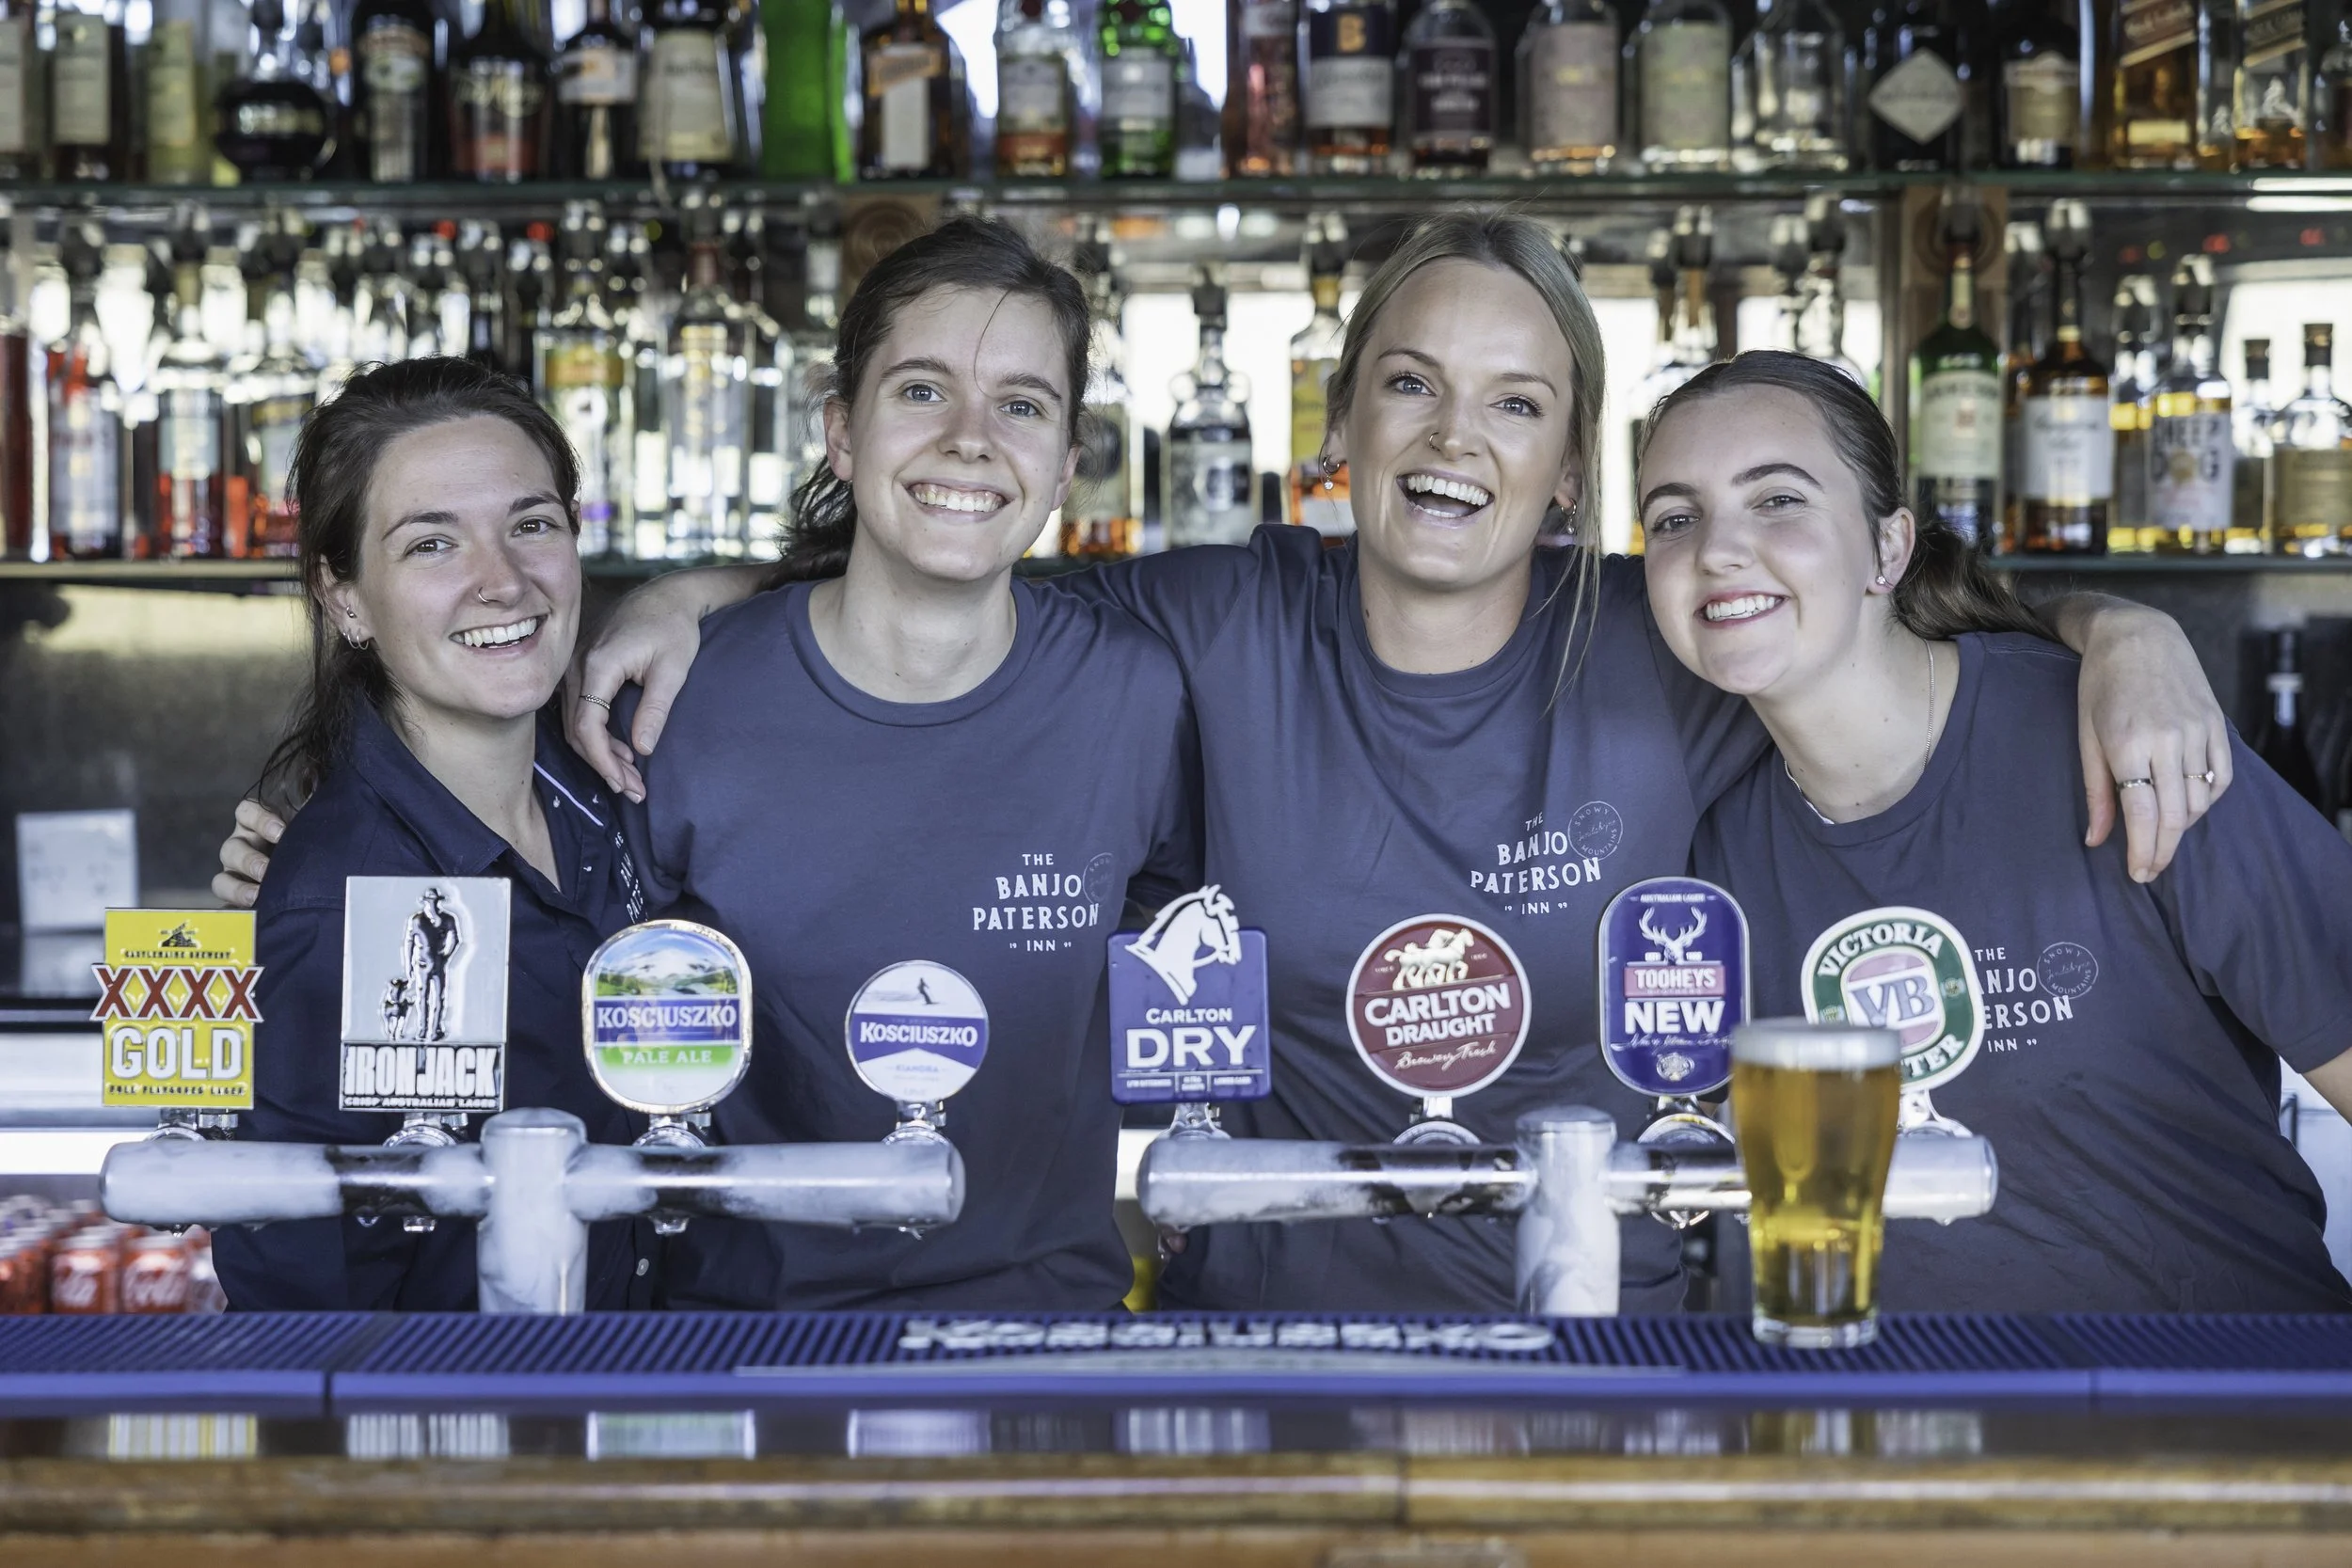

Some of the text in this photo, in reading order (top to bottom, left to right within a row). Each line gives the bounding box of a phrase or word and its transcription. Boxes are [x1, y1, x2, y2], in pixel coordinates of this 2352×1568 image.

[1525, 811, 1544, 832] THE
[1497, 831, 1568, 866] BANJO
[1581, 828, 1617, 856] MOUNTAINS
[1022, 853, 1055, 866] THE
[994, 873, 1082, 900] BANJO
[1470, 857, 1601, 895] PATERSON
[972, 903, 1100, 930] PATERSON
[1521, 901, 1550, 915] INN
[1026, 940, 1056, 952] INN
[1817, 922, 1945, 977] VICTORIA
[1975, 947, 2006, 962] THE
[1634, 968, 1717, 989] TOOHEYS
[1979, 967, 2037, 995] NJO
[2051, 969, 2091, 994] MOUNTAINS
[91, 964, 264, 1022] XXXX
[1364, 982, 1512, 1027] CARLTON
[1849, 974, 1935, 1027] VB
[596, 1004, 737, 1028] KOSCIUSZKO
[1145, 1007, 1232, 1024] CARLTON
[1624, 1000, 1726, 1035] NEW
[1984, 995, 2074, 1030] ERSON
[859, 1022, 978, 1048] KOSCIUSZKO
[1385, 1012, 1497, 1048] DRAUGHT
[111, 1026, 244, 1081] GOLD
[622, 1049, 713, 1065] PALE ALE
[1126, 1024, 1257, 1069] DRY
[1394, 1039, 1498, 1072] Brewery Fresh
[1900, 1033, 1965, 1078] TER
[1987, 1037, 2018, 1053] INN
[344, 1097, 381, 1106] CRISP
[382, 1097, 455, 1107] AUSTRALIAN
